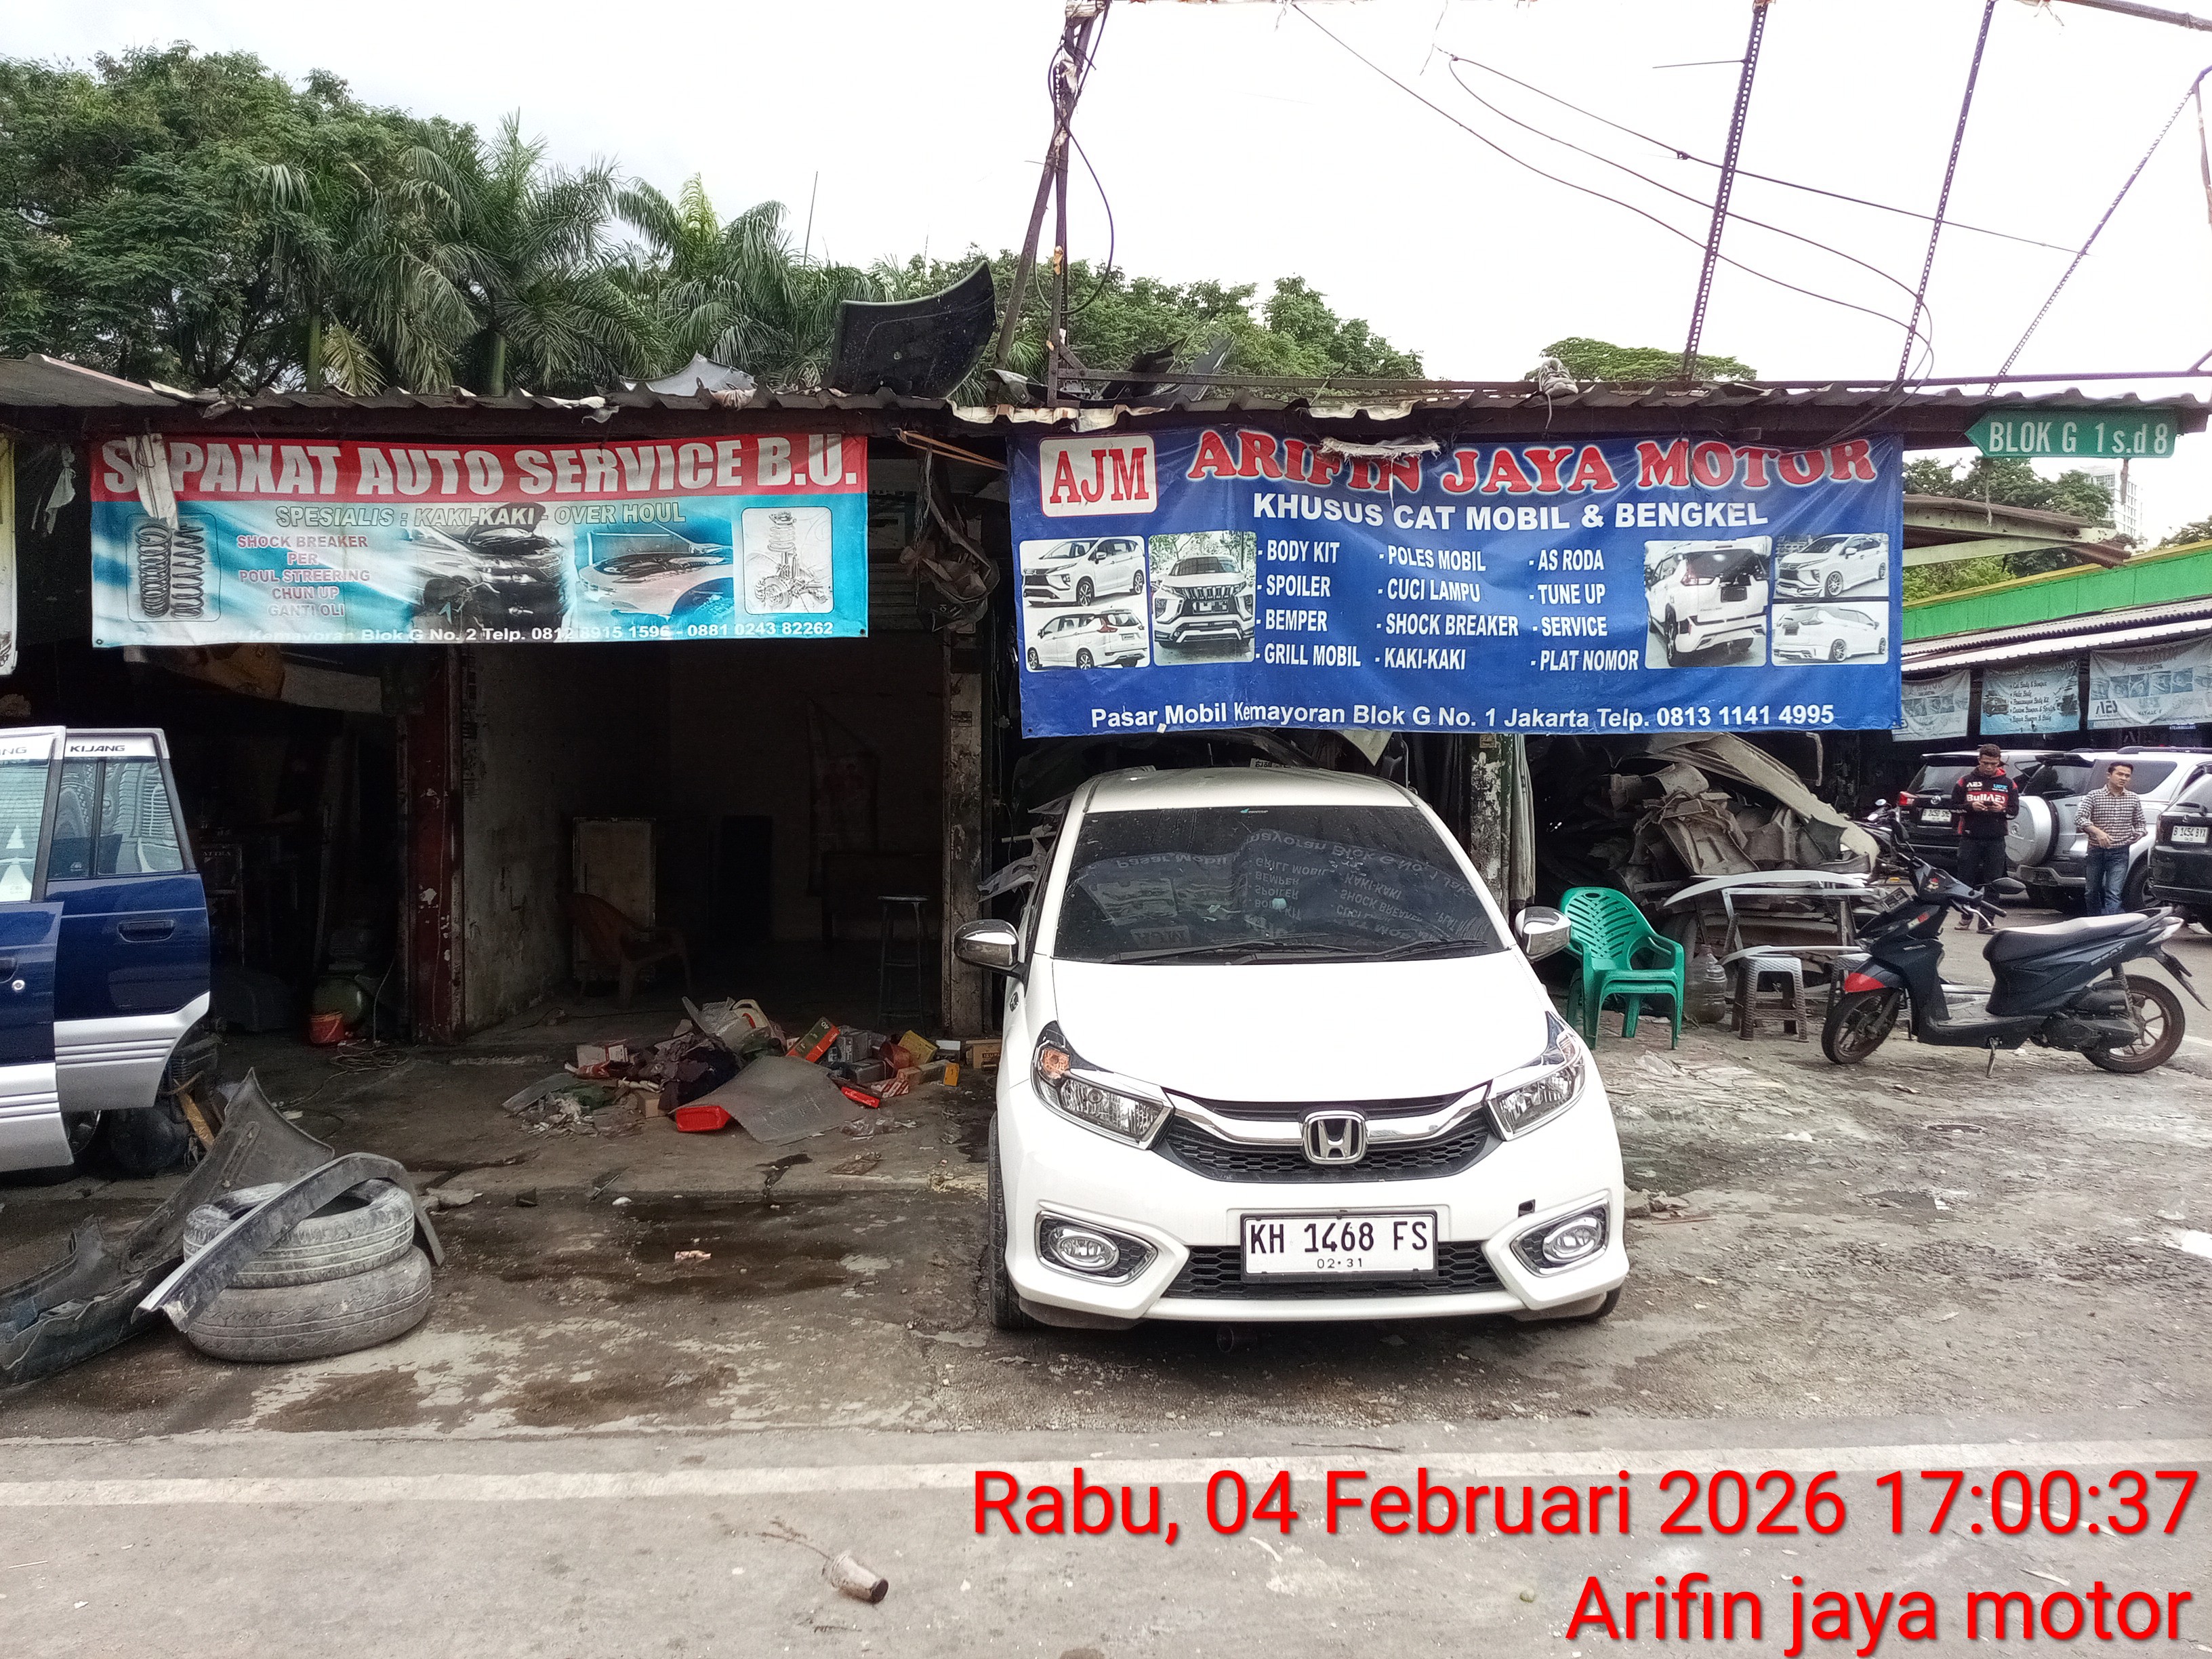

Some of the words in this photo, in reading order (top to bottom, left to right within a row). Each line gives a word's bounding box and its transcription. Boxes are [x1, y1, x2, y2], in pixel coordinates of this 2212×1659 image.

[1990, 422, 2051, 453] BLOK
[2062, 422, 2078, 453] G
[102, 438, 341, 494] SPAKAT
[357, 447, 504, 495] AUTO
[514, 439, 742, 494] SERVICE
[757, 434, 857, 487] B.U.
[1187, 430, 1424, 493] ARIFIN
[1441, 444, 1619, 495] JAYA
[1635, 437, 1878, 489] MOTOR
[1050, 447, 1150, 505] AJM
[276, 506, 394, 527] SPESIALIS
[415, 507, 535, 527] KAKI-KAKI
[554, 505, 616, 525] OVER
[622, 501, 686, 524] HOUL
[1254, 492, 1383, 527] KHUSUS
[1393, 504, 1456, 531] CAT
[1466, 506, 1570, 531] MOBIL
[1581, 504, 1605, 529] &
[1615, 501, 1769, 529] BENGKEL
[237, 535, 289, 549] SHOCK
[291, 535, 369, 548] BREAKER
[1267, 540, 1311, 563] BODY
[1313, 541, 1340, 563] KIT
[287, 552, 319, 565] PER
[1388, 545, 1435, 569] POLES
[1438, 548, 1487, 572] MOBIL
[1538, 549, 1559, 571] AS
[1562, 548, 1605, 571] RODA
[239, 570, 280, 583] POUL
[282, 569, 370, 583] STREERING
[1267, 575, 1331, 598] SPOILER
[272, 587, 314, 600] CHUN
[318, 586, 340, 600] UP
[1387, 577, 1426, 601] CUCI
[1429, 579, 1481, 604] LAMPU
[1538, 582, 1586, 605] TUNE
[1589, 581, 1606, 605] UP
[267, 604, 314, 617] GANTI
[319, 604, 345, 617] OLI
[1266, 608, 1328, 633] BEMPER
[361, 628, 406, 642] Blok
[409, 628, 424, 642] G
[429, 628, 461, 642] No.
[465, 629, 477, 641] 2
[483, 628, 526, 642] Telp.
[531, 626, 573, 640] 0812
[687, 624, 729, 637] 0881
[735, 623, 777, 636] 0243
[781, 621, 834, 635] 82262
[1386, 612, 1441, 637] SHOCK
[1444, 613, 1519, 638] BREAKER
[1541, 614, 1608, 638] SERVICE
[1265, 642, 1309, 667] GRILL
[1313, 644, 1362, 668] MOBIL
[1385, 647, 1466, 672] KAKI-KAKI
[1540, 649, 1580, 672] PLAT
[1582, 649, 1639, 672] NOMOR
[1091, 708, 1158, 729] Pasar
[1166, 702, 1227, 724] Mobil
[1234, 701, 1346, 726] Kemayoran
[1353, 705, 1406, 726] Blok
[1412, 707, 1432, 727] G
[1438, 708, 1477, 727] No.
[1484, 708, 1496, 727] 1
[1504, 708, 1589, 728] Jakarta
[1596, 708, 1650, 730] Telp.
[1656, 707, 1711, 726] 0813
[1718, 705, 1770, 725] 1141
[1778, 703, 1834, 724] 4995
[1250, 1223, 1284, 1254] KH
[1304, 1222, 1374, 1253] 1468
[1393, 1221, 1427, 1250] FS
